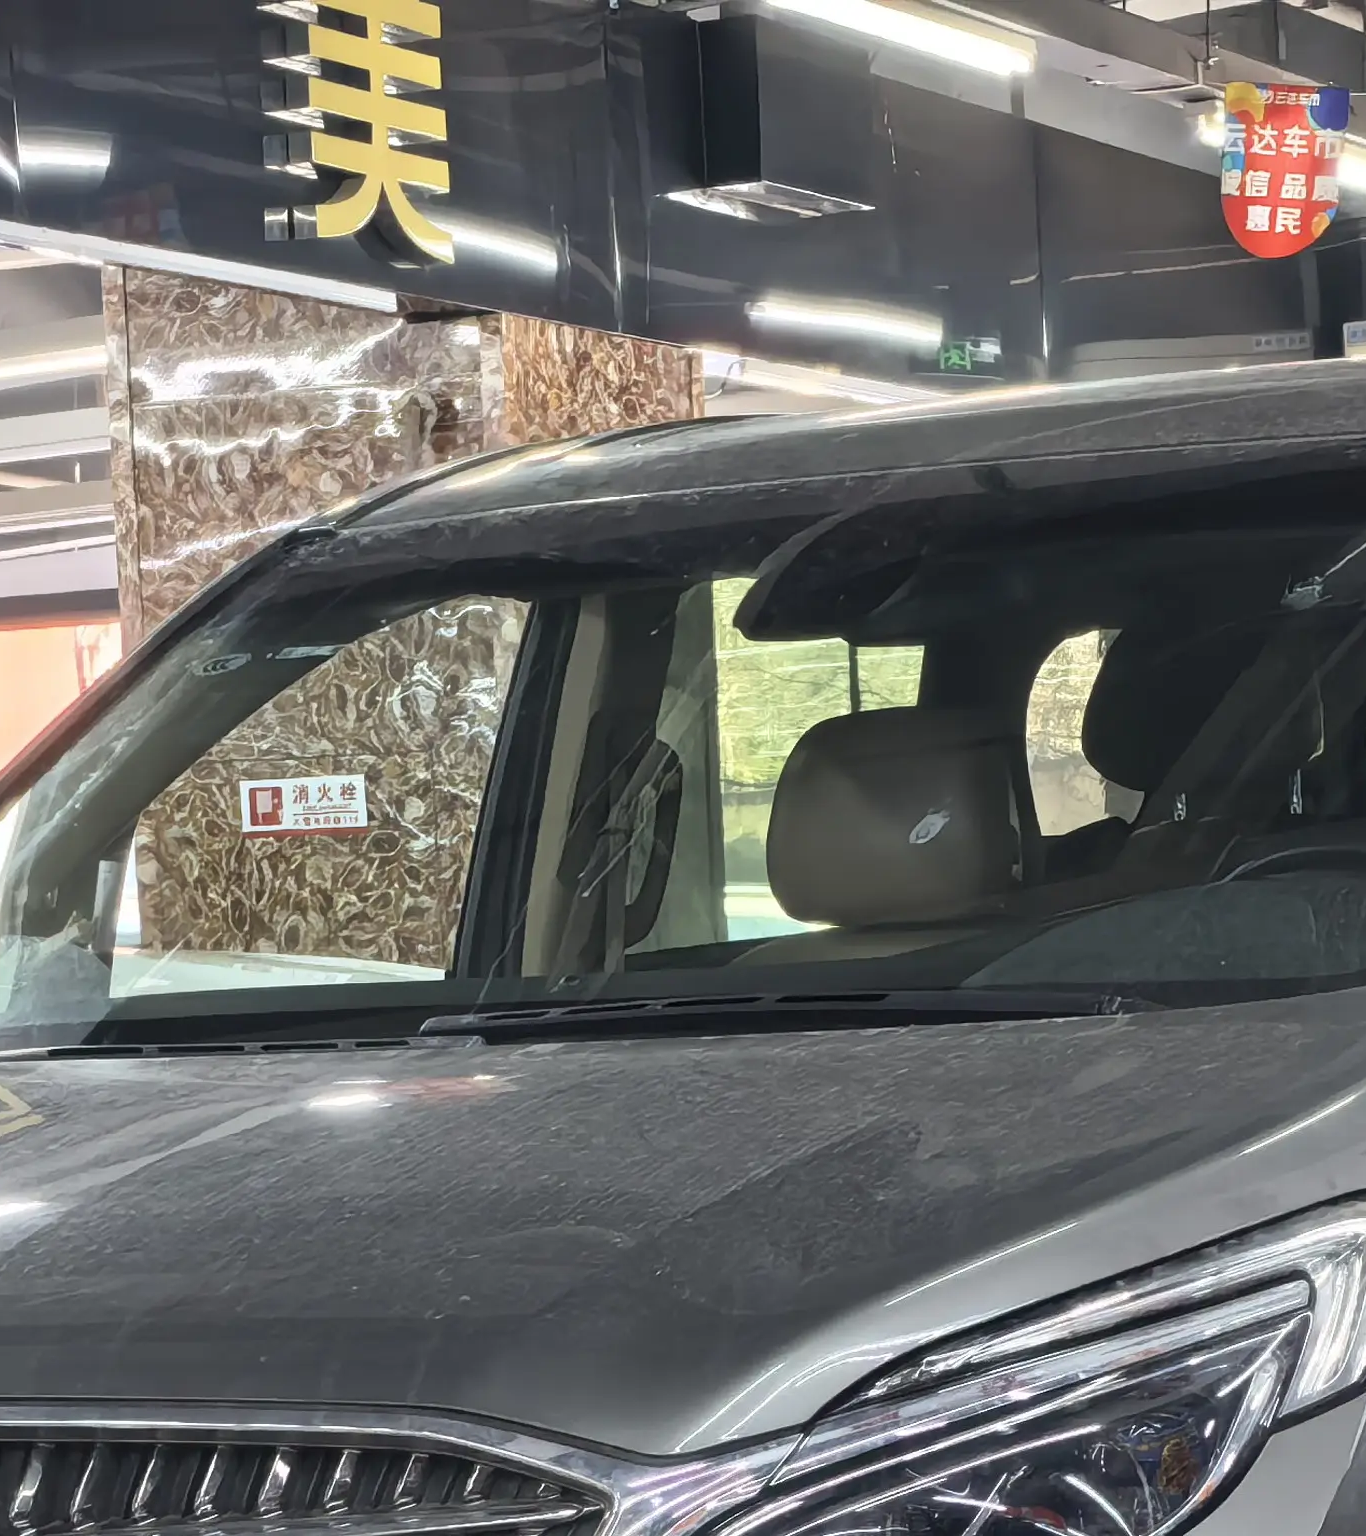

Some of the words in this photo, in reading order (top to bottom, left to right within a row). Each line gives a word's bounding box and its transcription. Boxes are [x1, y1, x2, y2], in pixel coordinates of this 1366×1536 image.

[1224, 124, 1343, 159] 云达车市
[292, 781, 357, 804] 消火栓
